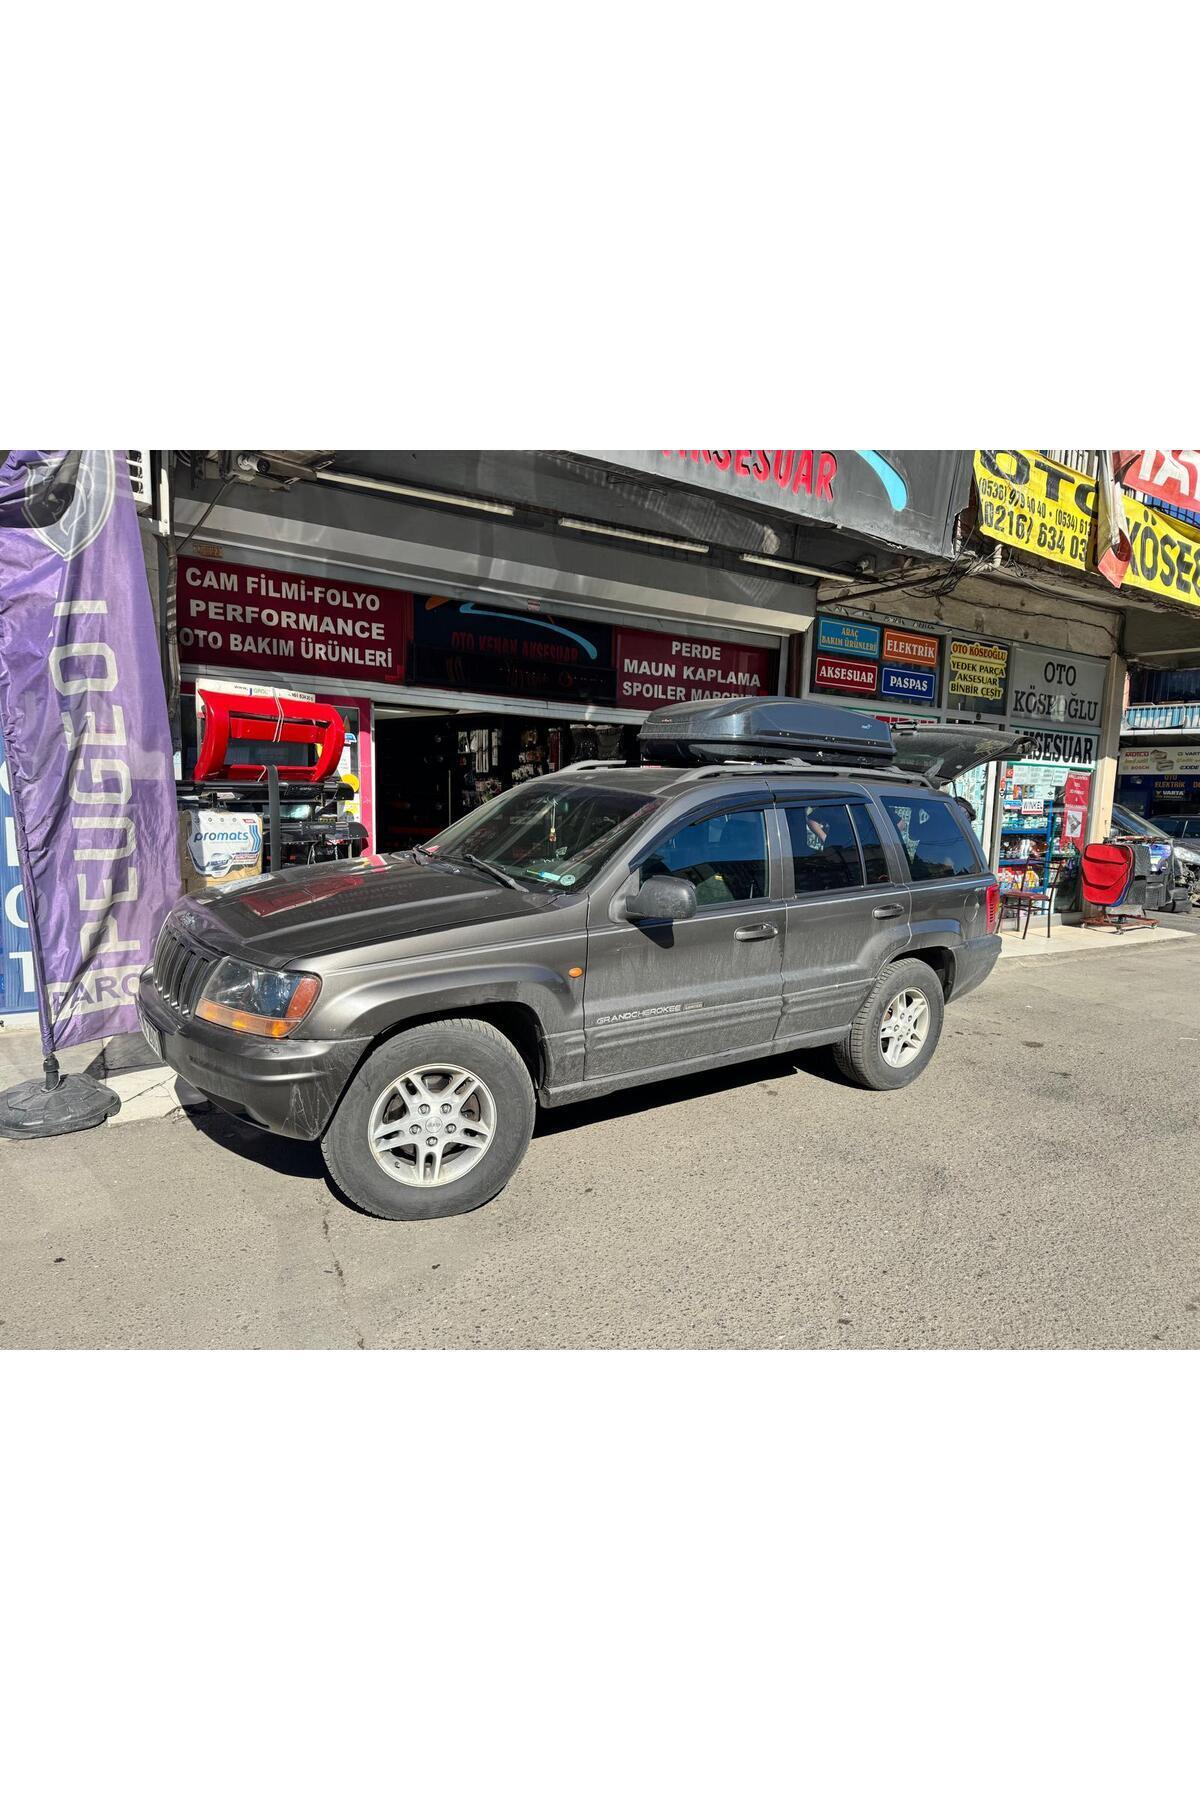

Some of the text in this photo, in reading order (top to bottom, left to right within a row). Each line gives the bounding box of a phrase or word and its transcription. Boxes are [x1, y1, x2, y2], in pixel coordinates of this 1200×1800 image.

[1037, 501, 1046, 518] 40
[1055, 508, 1078, 532] (0534)
[1037, 522, 1065, 554] 634
[186, 567, 380, 611] CAM FİLMİ-FOLYO
[190, 599, 385, 640] PERFORMANCE
[179, 627, 393, 668] OTO BAKIM ÜRÜNLERİ
[821, 636, 843, 645] BAKIM
[887, 640, 935, 658] ELEKTRİK
[952, 643, 967, 654] OTO
[672, 641, 721, 661] PERDE
[624, 659, 761, 687] MAUN KAPLAMA
[819, 665, 874, 683] AKSESUAR
[952, 660, 1005, 677] YEDEK PARÇA
[1044, 661, 1077, 686] OTO
[890, 676, 928, 691] PASPAS
[957, 673, 998, 686] AKSESUAR
[622, 682, 686, 701] SPOILER
[951, 682, 1002, 699] BİNBİR ÇEŞİT
[193, 831, 249, 843] promats
